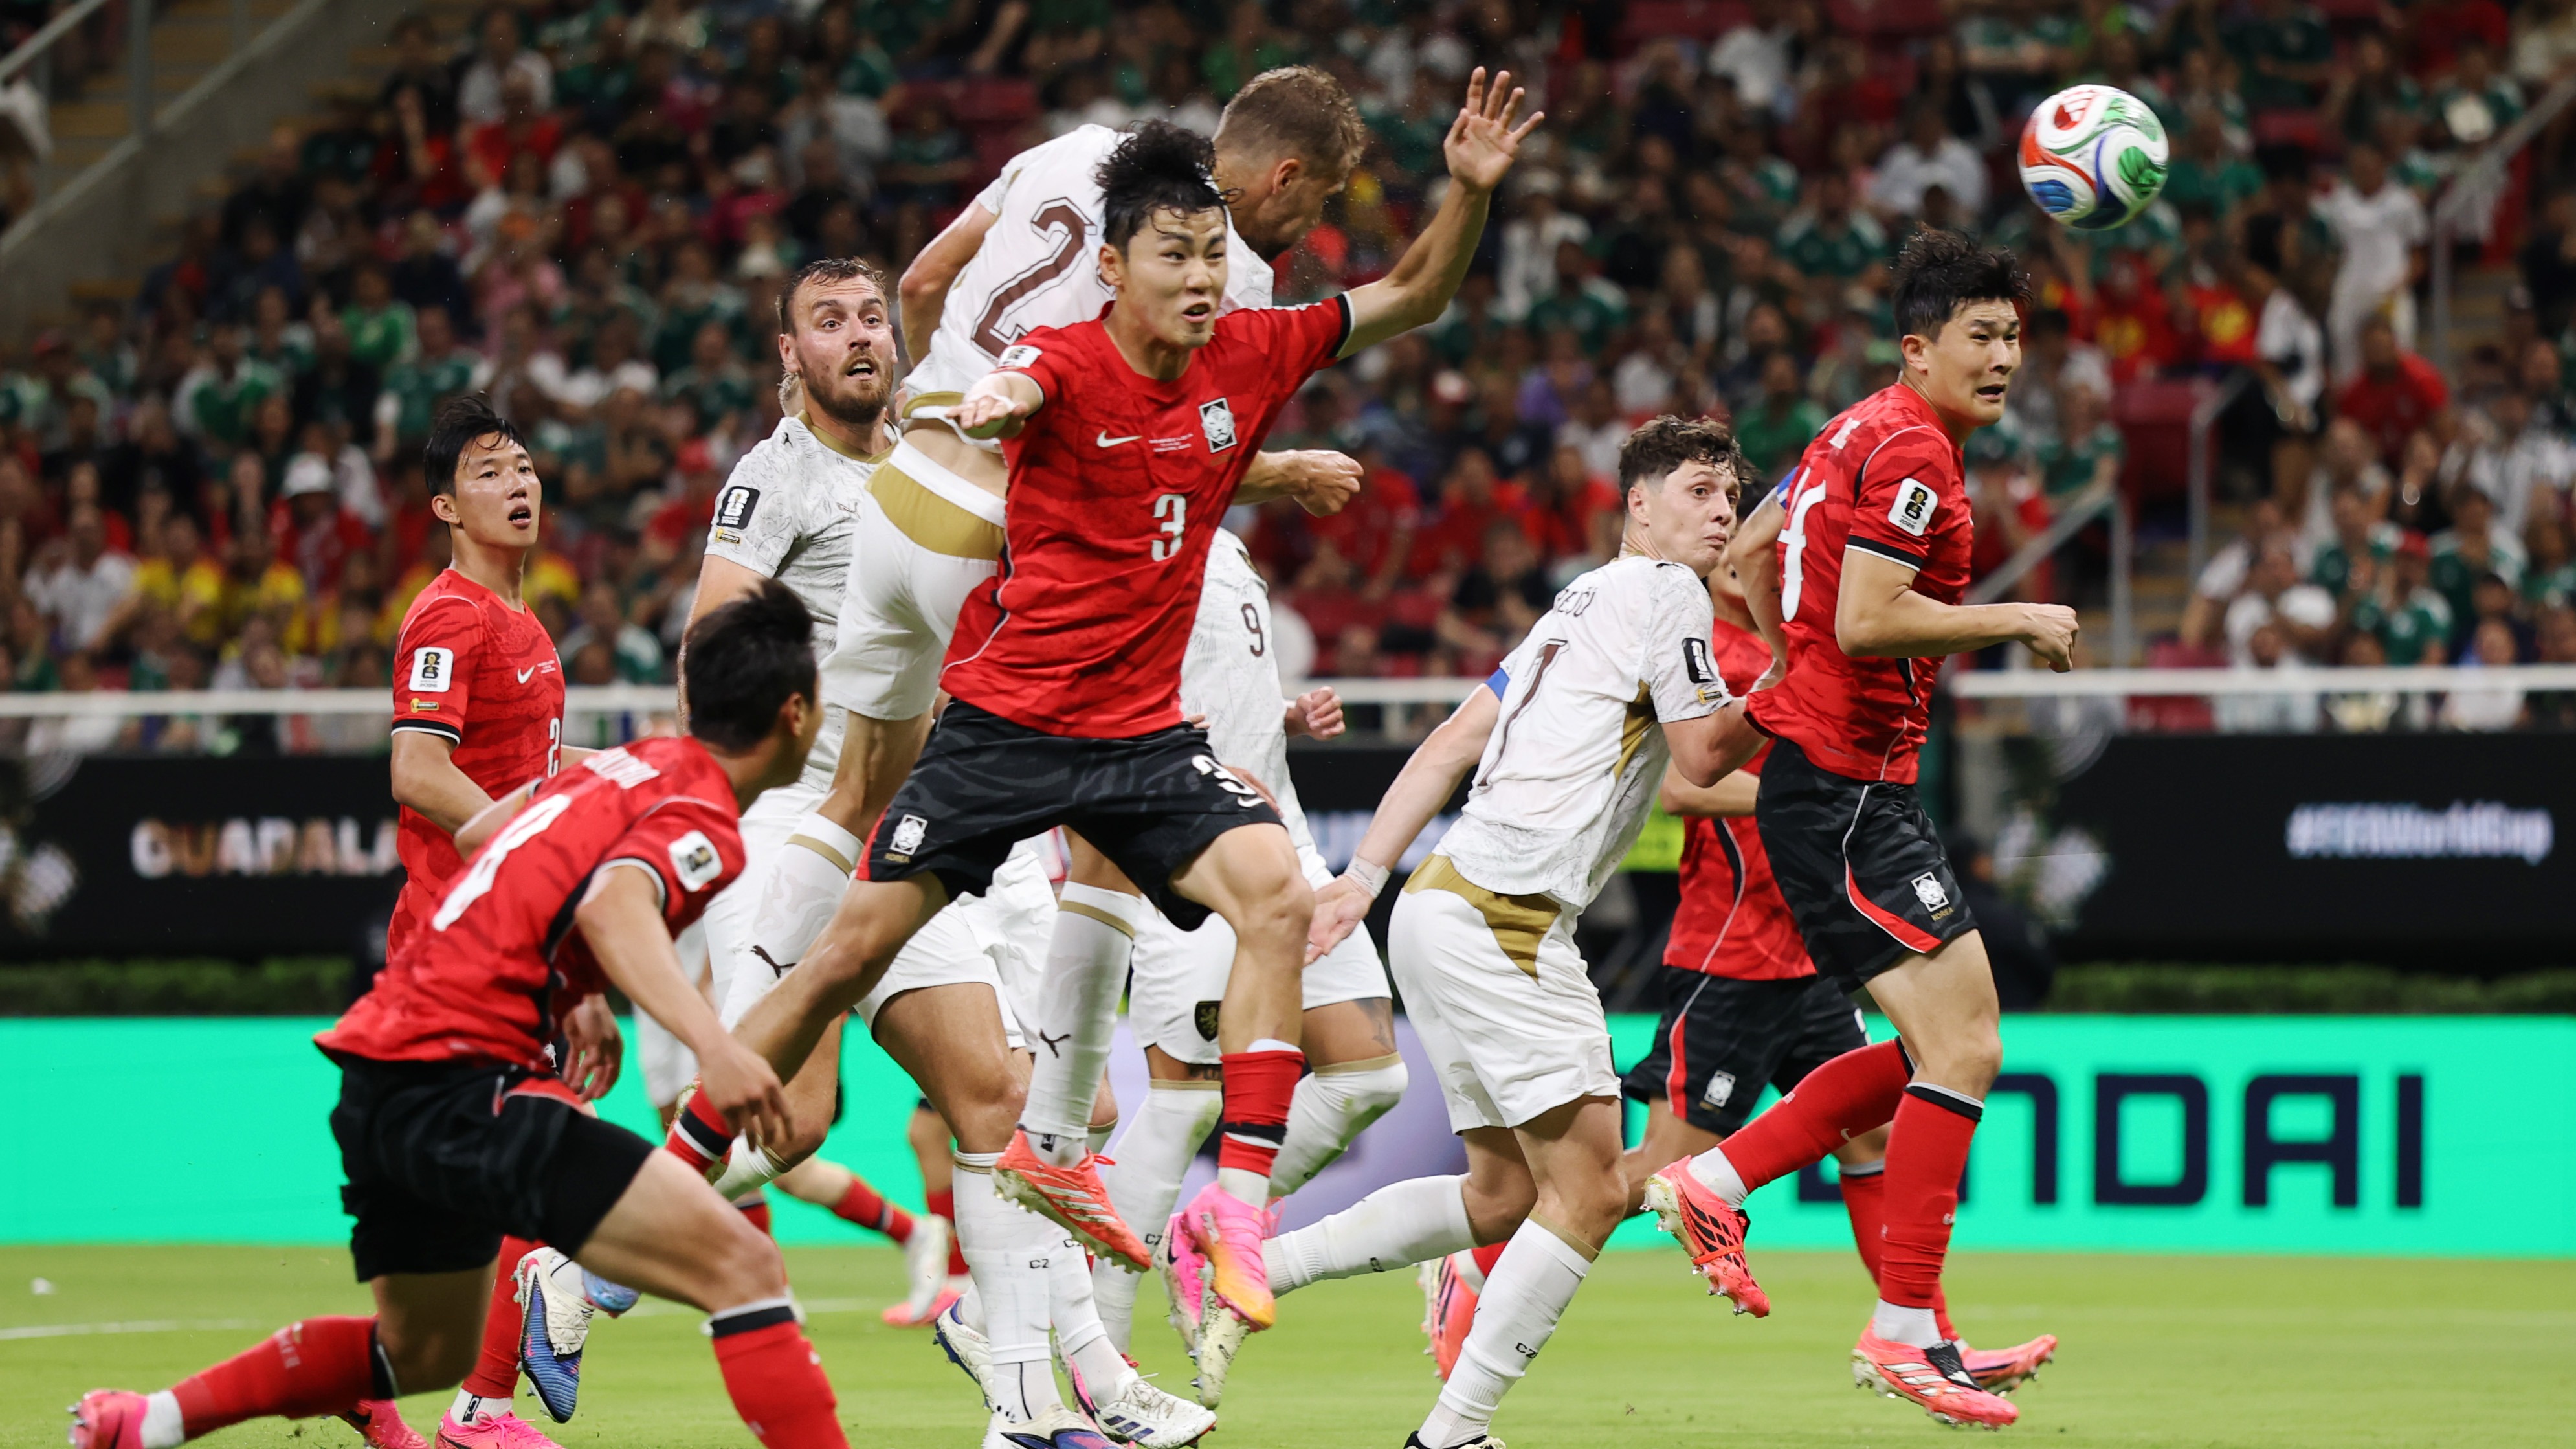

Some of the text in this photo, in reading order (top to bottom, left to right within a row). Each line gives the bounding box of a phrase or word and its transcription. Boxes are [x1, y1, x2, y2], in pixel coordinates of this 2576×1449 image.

[970, 196, 1118, 366] 2
[1151, 494, 1186, 562] 3
[1777, 465, 1827, 622] 4
[1241, 603, 1265, 658] 9
[547, 717, 561, 778] 2
[1192, 754, 1257, 795] 3
[1931, 906, 1955, 921] KOREA
[1029, 1259, 1049, 1269] CZ
[1063, 1239, 1083, 1248] C
[1516, 1342, 1538, 1359] CZ
